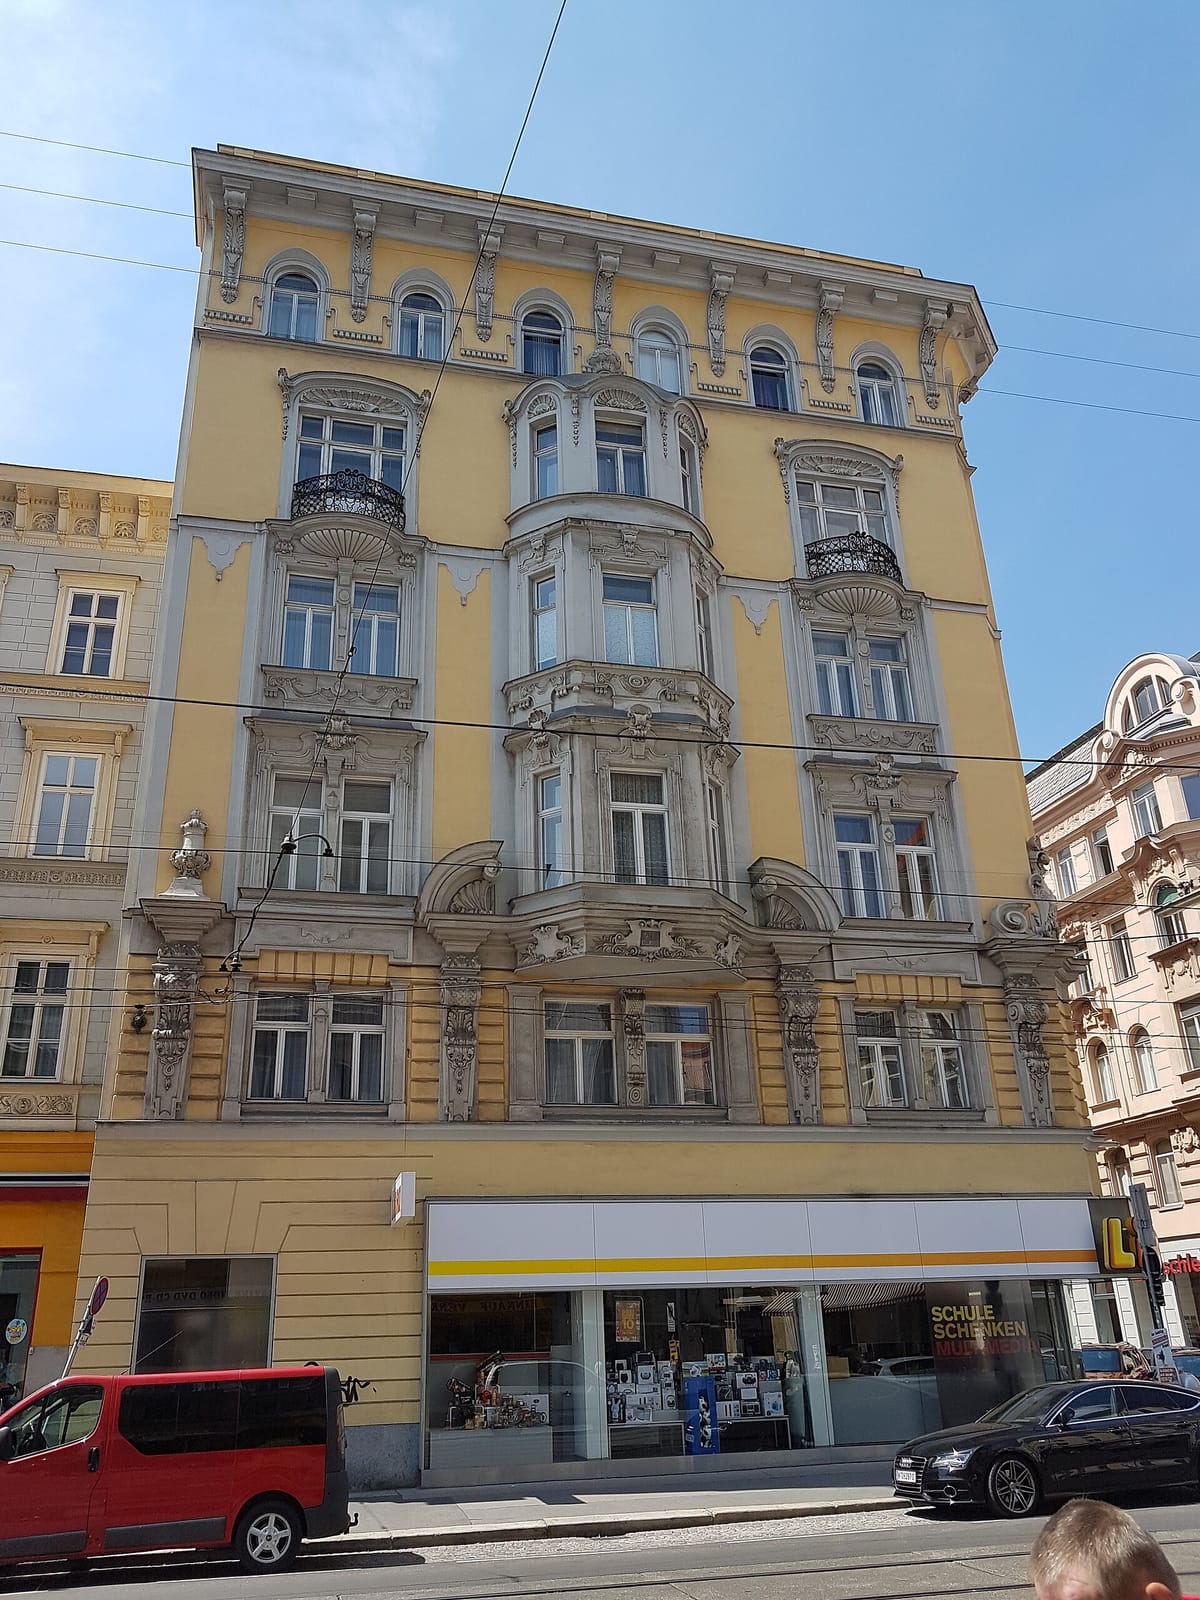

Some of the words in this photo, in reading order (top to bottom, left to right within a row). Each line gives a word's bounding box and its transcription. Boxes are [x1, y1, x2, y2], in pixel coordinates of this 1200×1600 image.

[1162, 1253, 1200, 1275] schle
[931, 1305, 995, 1322] SCHULE
[933, 1321, 1027, 1339] SCHENKEN
[935, 1339, 1038, 1356] MULTMEDIA
